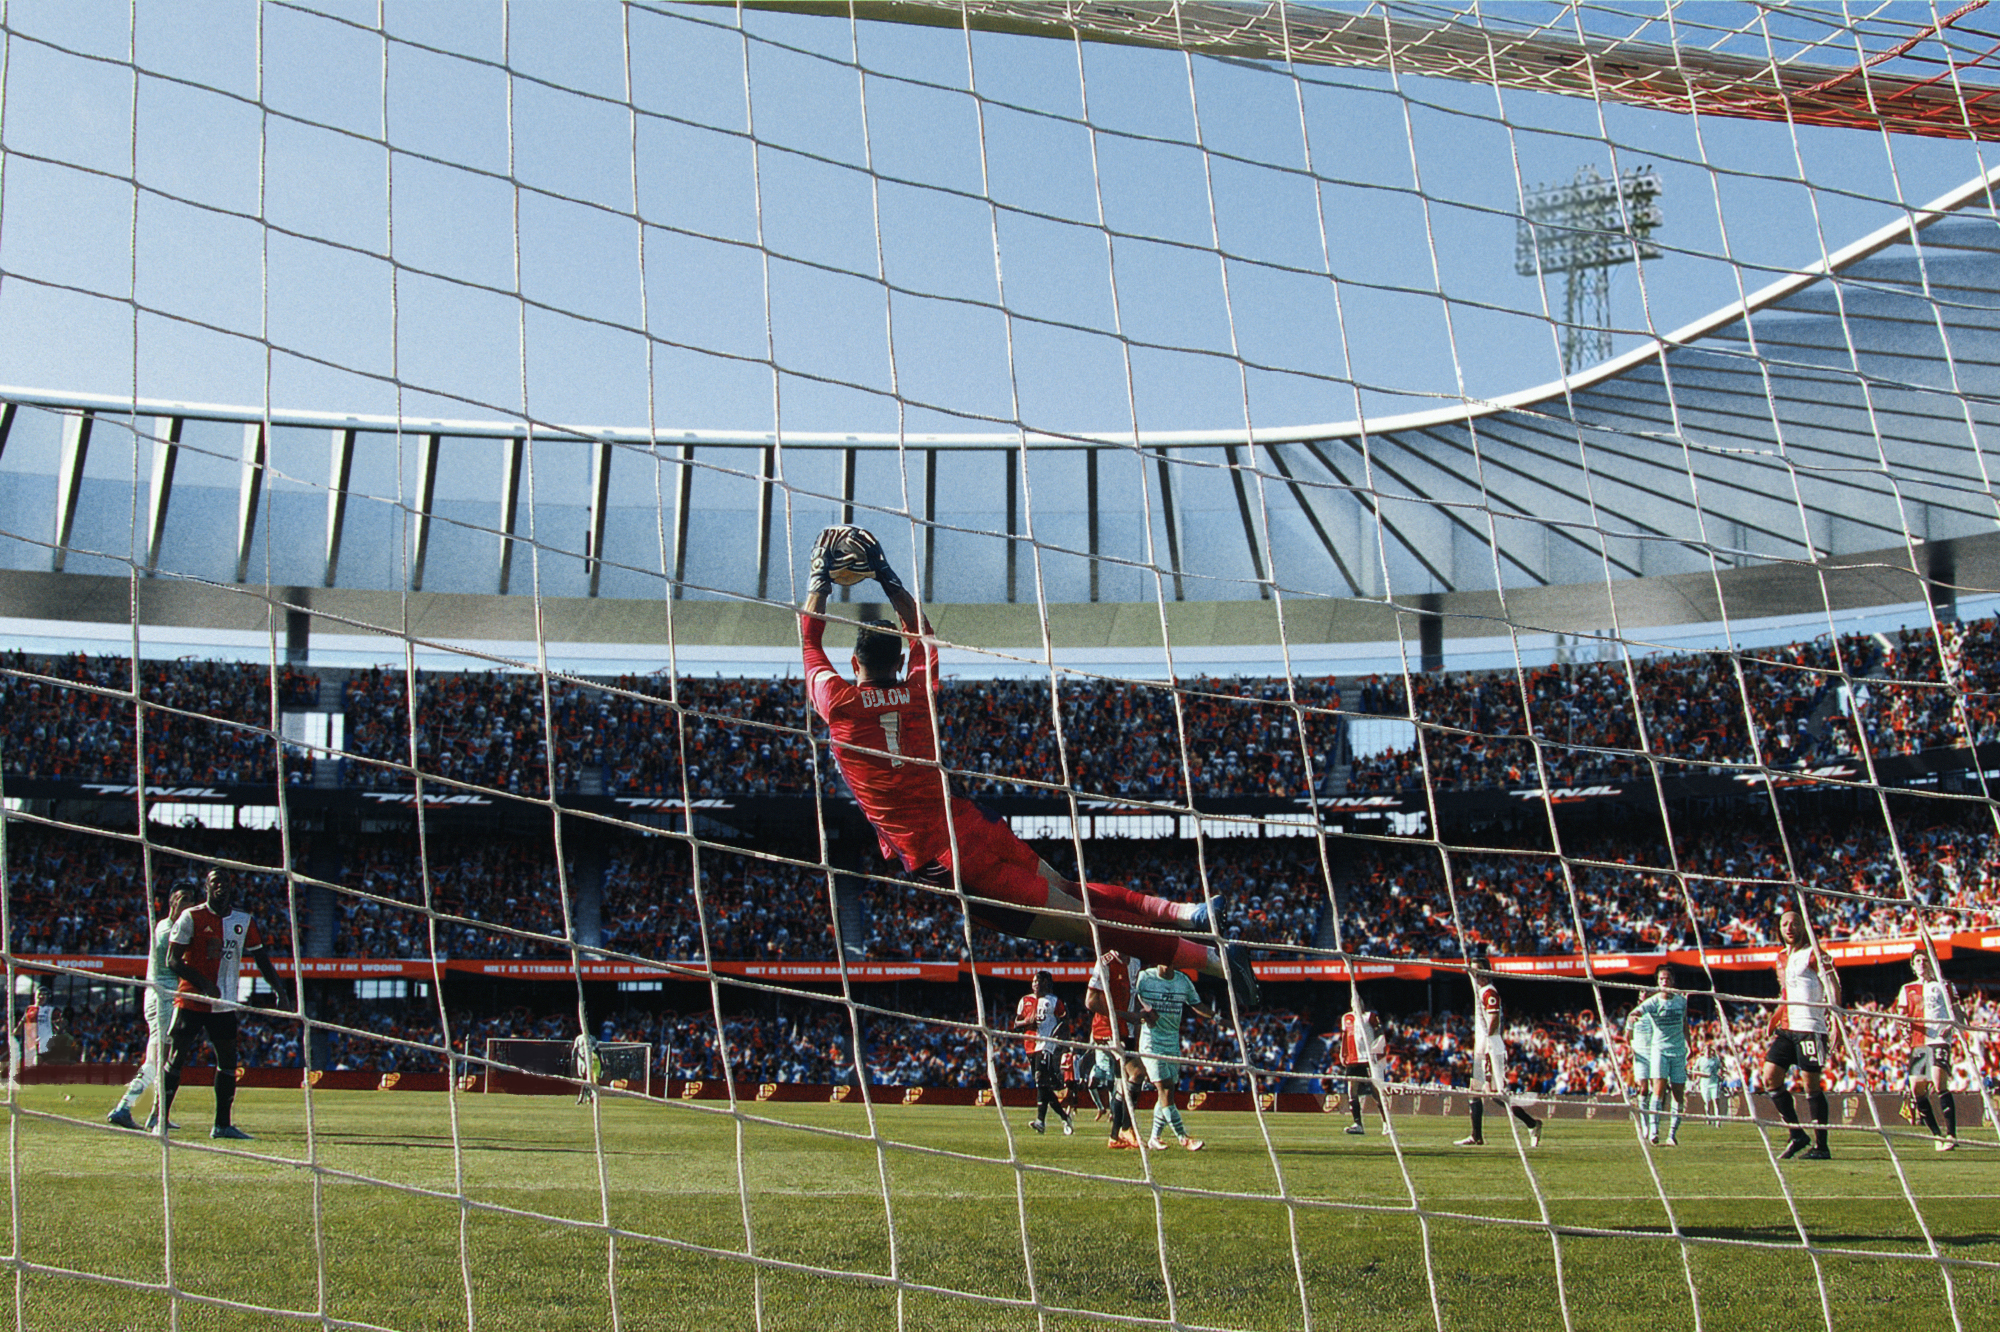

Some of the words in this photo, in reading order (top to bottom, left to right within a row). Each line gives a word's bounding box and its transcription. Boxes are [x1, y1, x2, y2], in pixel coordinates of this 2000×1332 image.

[861, 687, 911, 708] BIJLOW
[880, 710, 903, 768] 1
[317, 963, 337, 971] DAT
[361, 964, 403, 972] WOORD
[592, 966, 611, 974] DAT
[1800, 1040, 1816, 1056] 18
